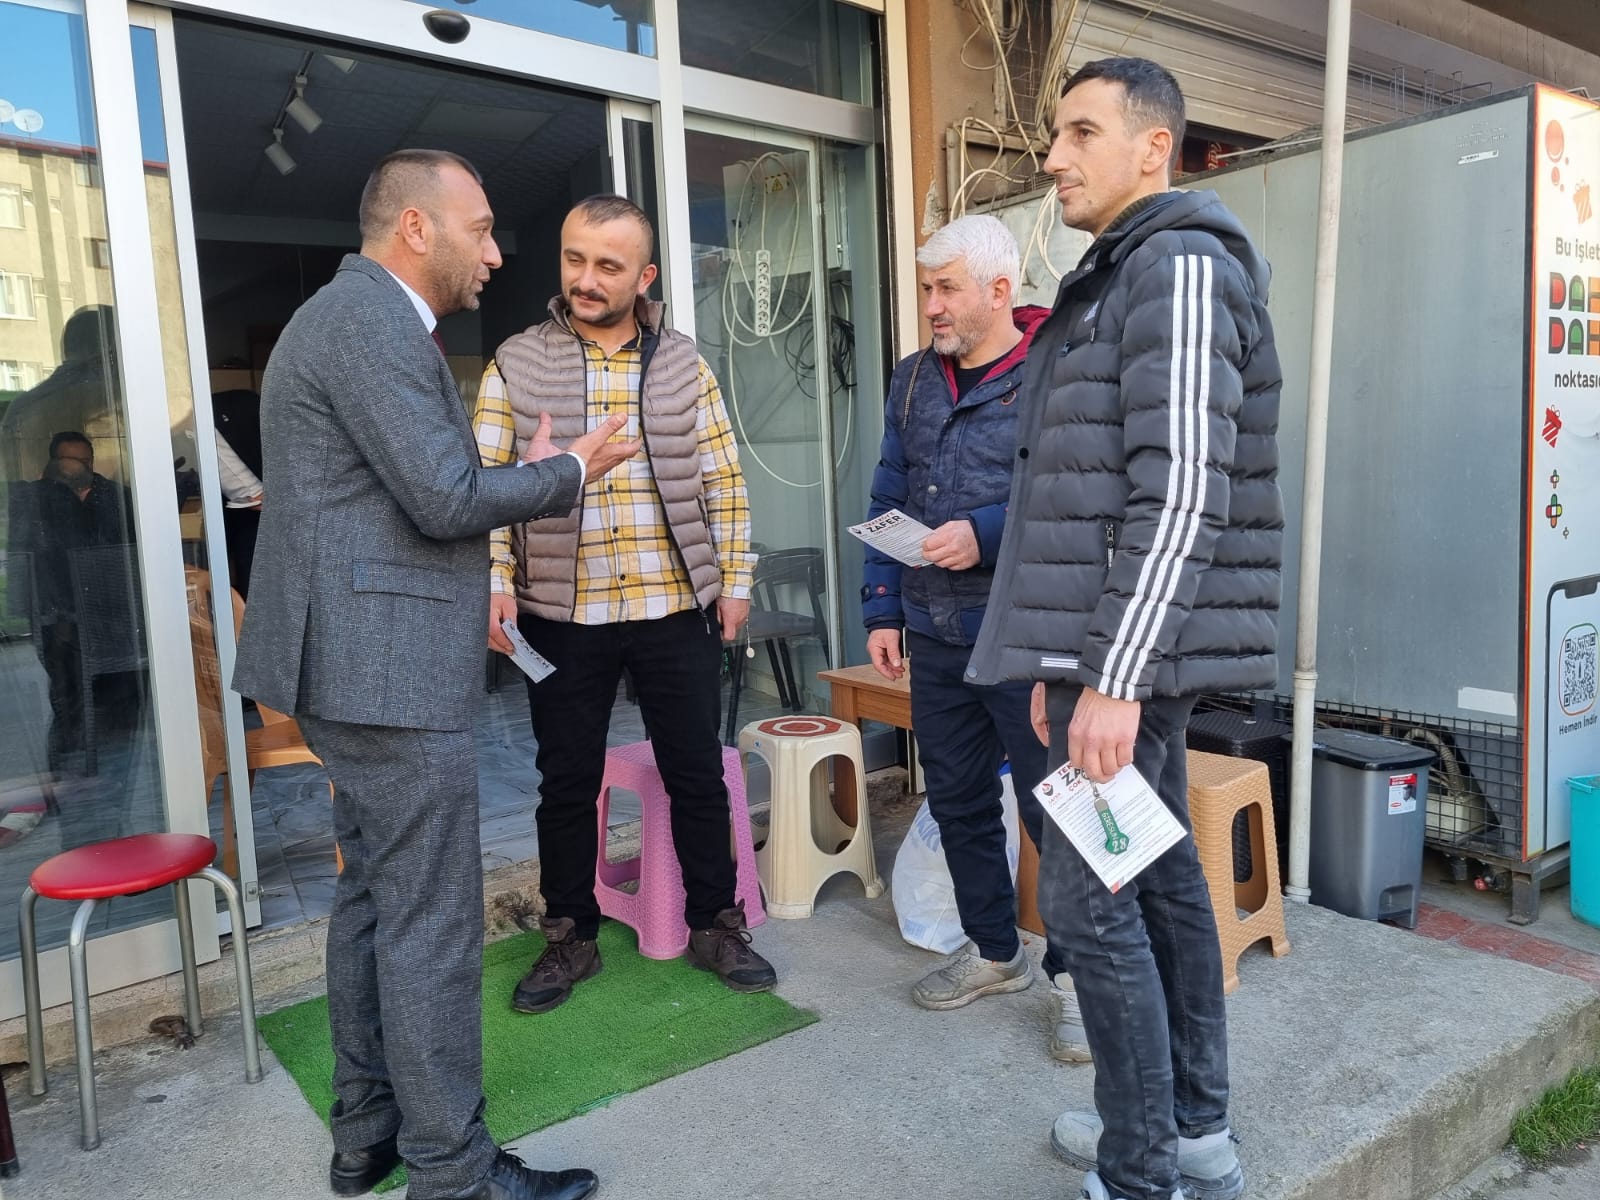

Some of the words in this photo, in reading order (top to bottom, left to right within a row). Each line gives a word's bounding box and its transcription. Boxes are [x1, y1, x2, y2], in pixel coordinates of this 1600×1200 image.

[1556, 236, 1572, 256] Bu
[866, 515, 902, 533] ZAFER
[1559, 721, 1582, 735] Hemen
[1112, 837, 1127, 852] 28
